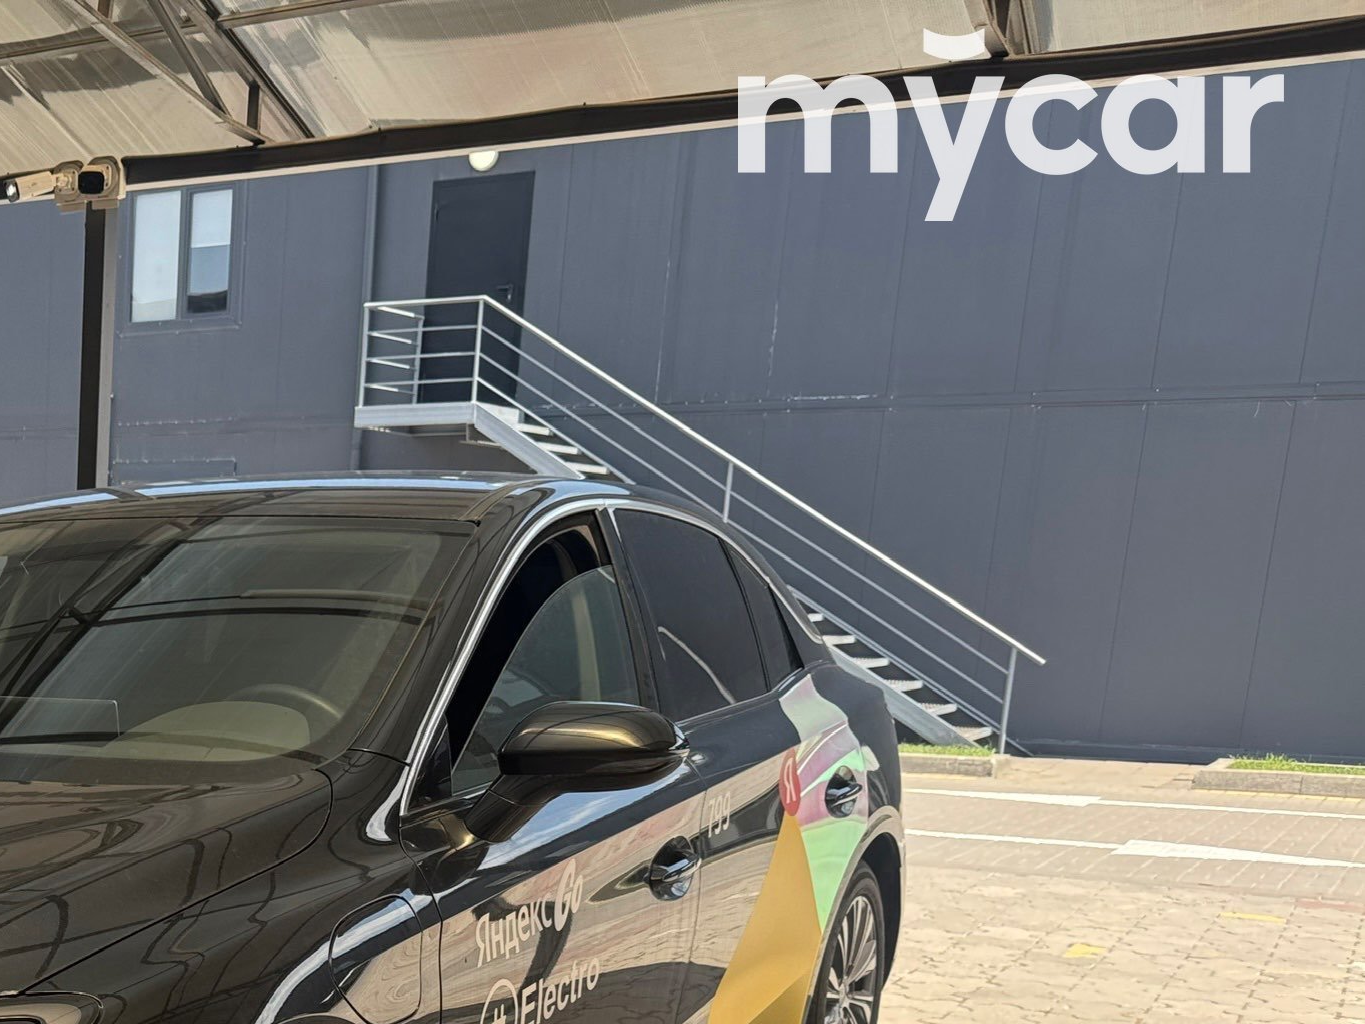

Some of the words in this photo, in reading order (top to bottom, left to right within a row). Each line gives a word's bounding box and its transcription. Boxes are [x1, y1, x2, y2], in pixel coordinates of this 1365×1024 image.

[783, 756, 797, 805] Я
[475, 892, 553, 968] Яндекс
[553, 857, 584, 932] Go
